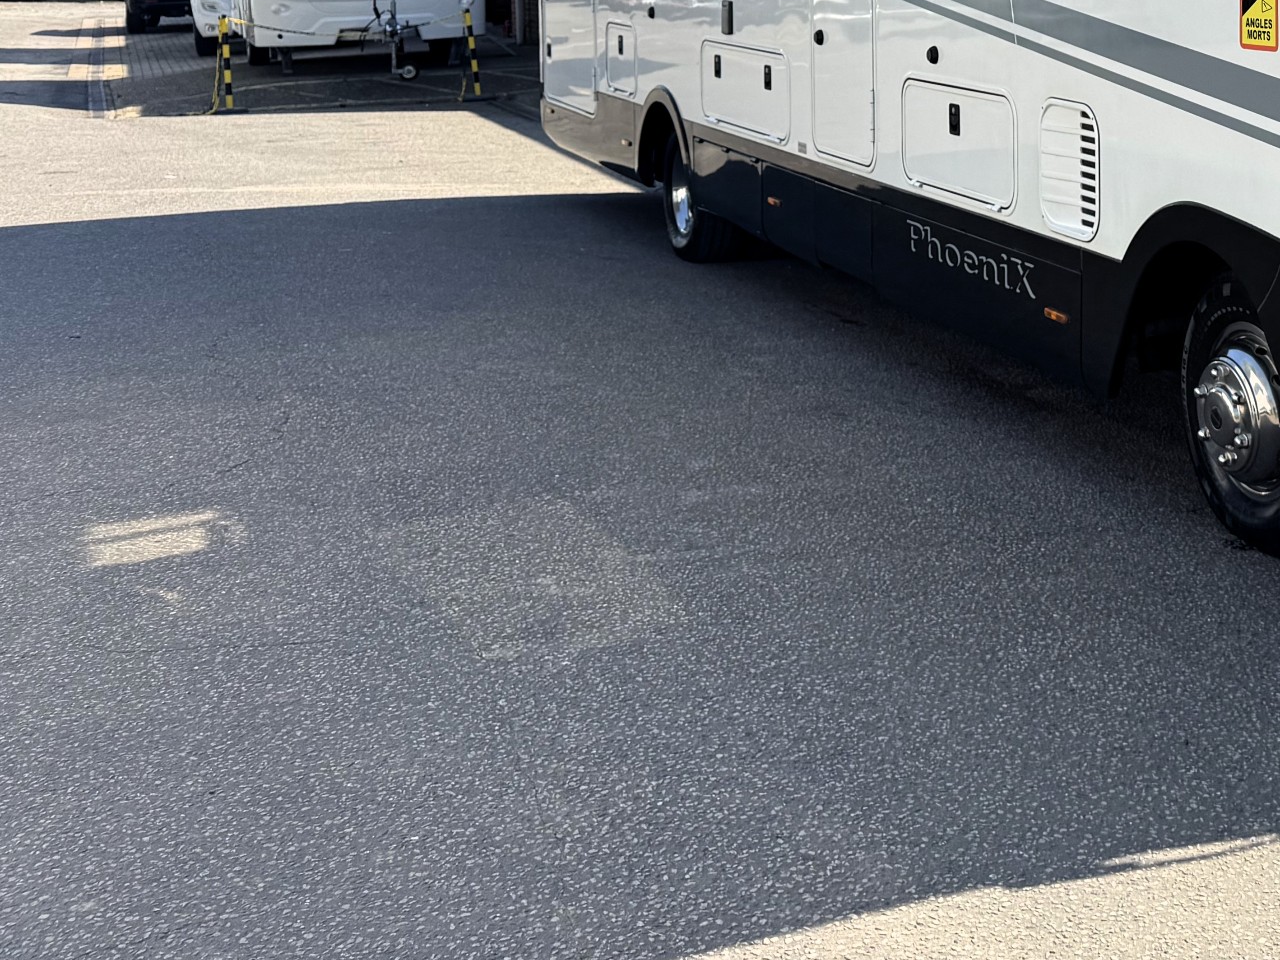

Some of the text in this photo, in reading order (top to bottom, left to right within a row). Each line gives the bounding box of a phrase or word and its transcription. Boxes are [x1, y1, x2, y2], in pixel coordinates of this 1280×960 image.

[1245, 17, 1273, 29] ANGLES
[1247, 29, 1271, 41] MORTS
[906, 219, 1036, 300] PhoeniX
